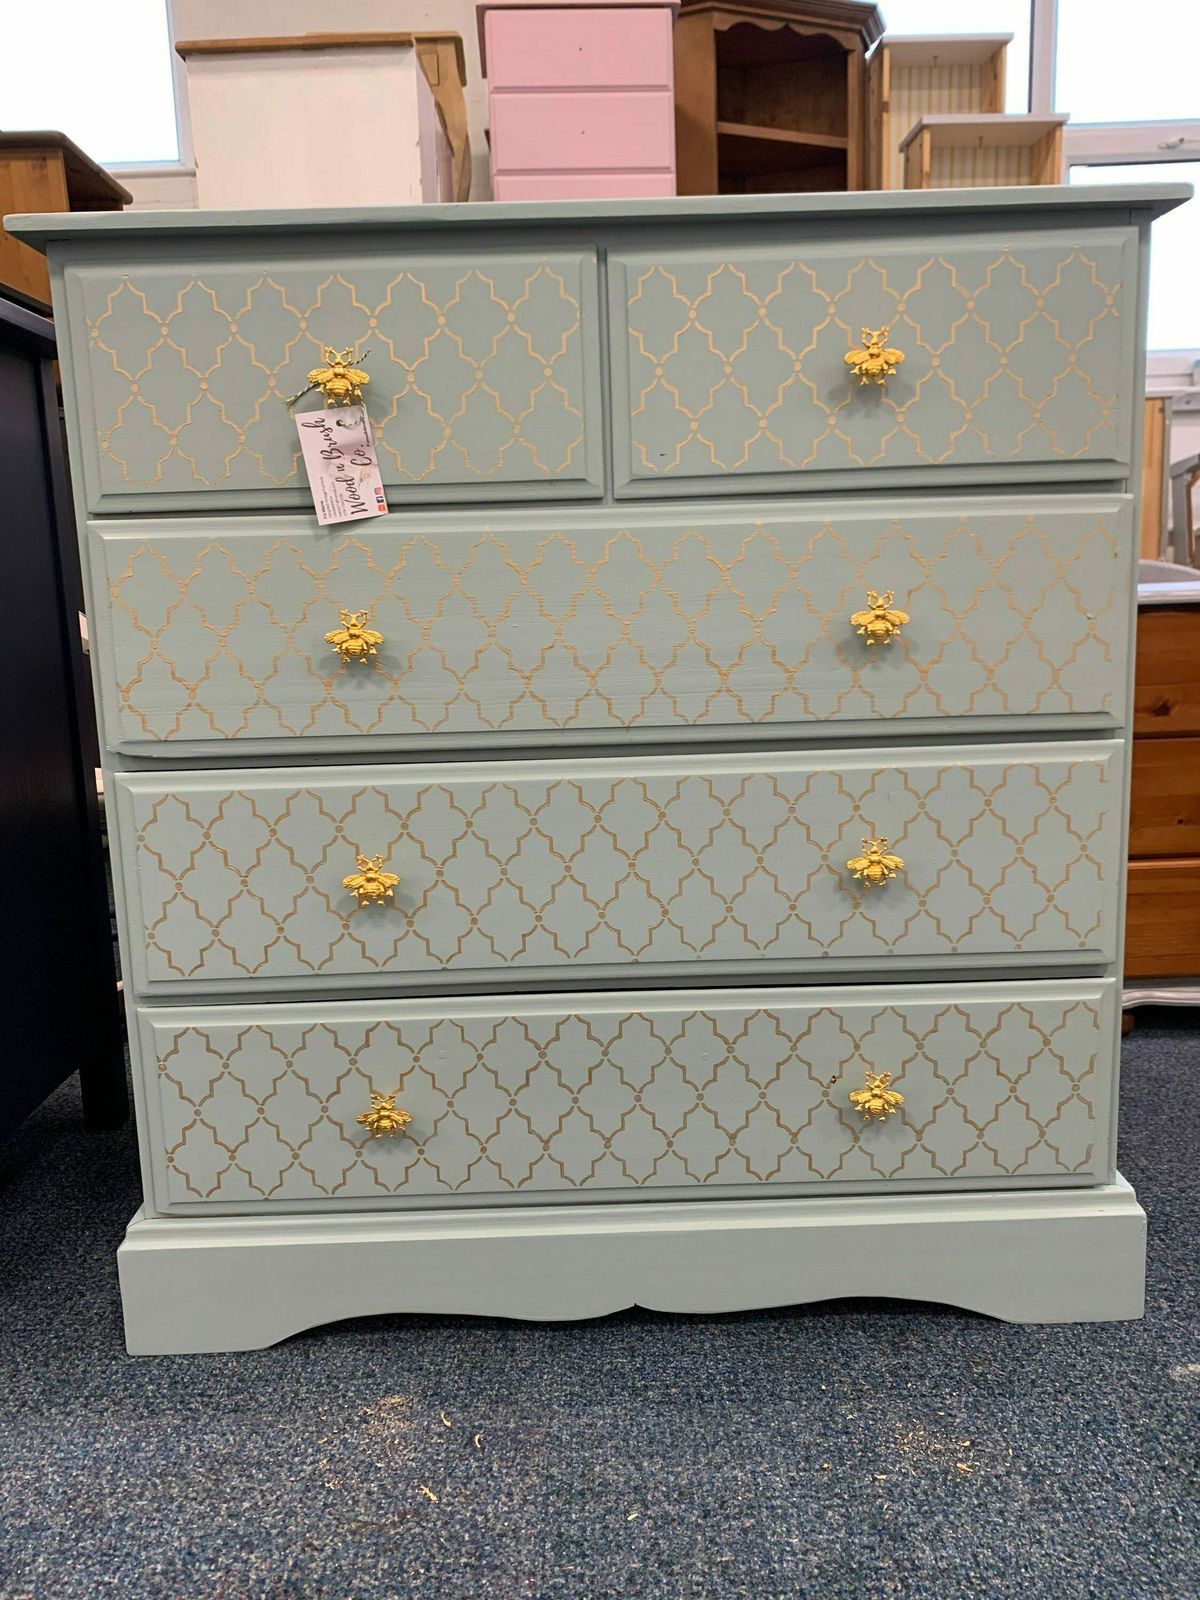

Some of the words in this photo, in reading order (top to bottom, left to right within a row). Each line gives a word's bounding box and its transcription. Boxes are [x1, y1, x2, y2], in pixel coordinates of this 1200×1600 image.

[301, 417, 344, 460] Brush
[336, 463, 345, 472] n
[350, 444, 372, 466] Co.
[335, 475, 368, 515] Wood
